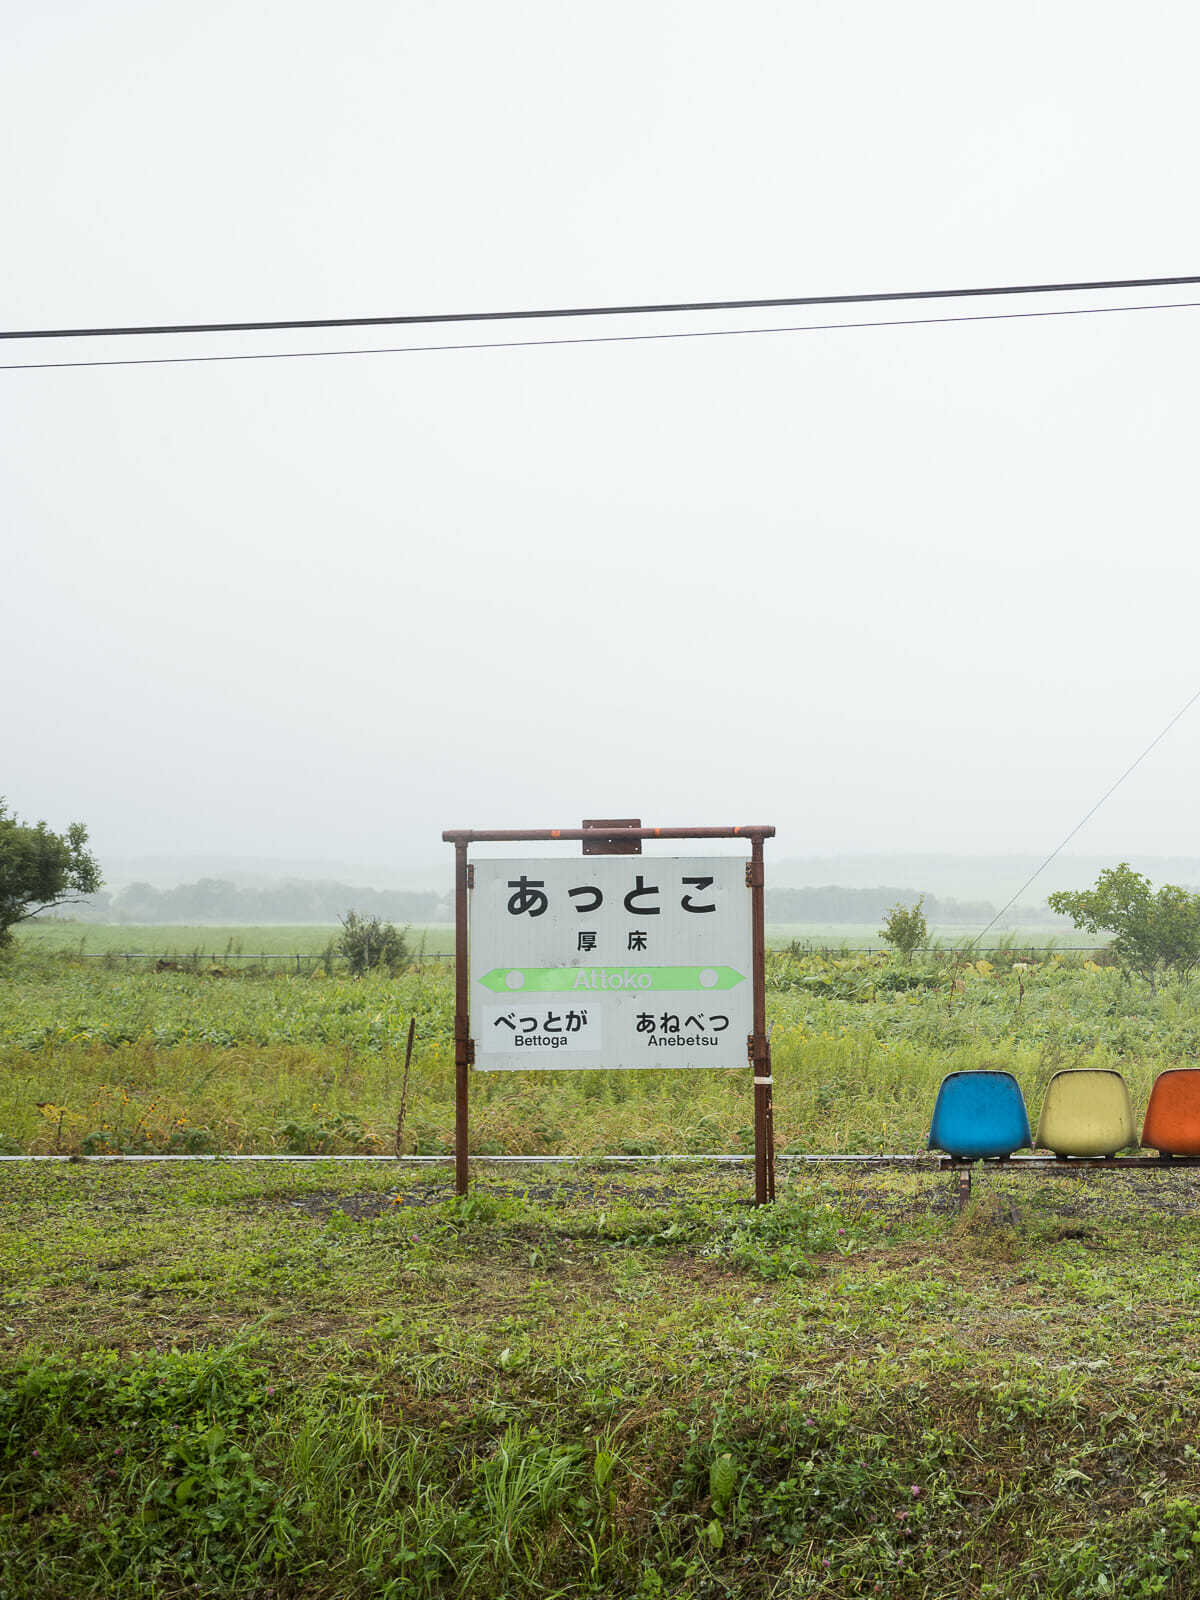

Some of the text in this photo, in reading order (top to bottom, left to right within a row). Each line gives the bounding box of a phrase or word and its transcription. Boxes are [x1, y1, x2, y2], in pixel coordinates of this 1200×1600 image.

[507, 875, 716, 918] あっとこ
[577, 931, 648, 952] 厚床
[573, 969, 652, 989] Attoko
[493, 1010, 588, 1033] べっとが
[636, 1012, 730, 1034] あねべつ
[514, 1035, 568, 1048] Bettoga
[647, 1034, 719, 1047] Anebetsu
